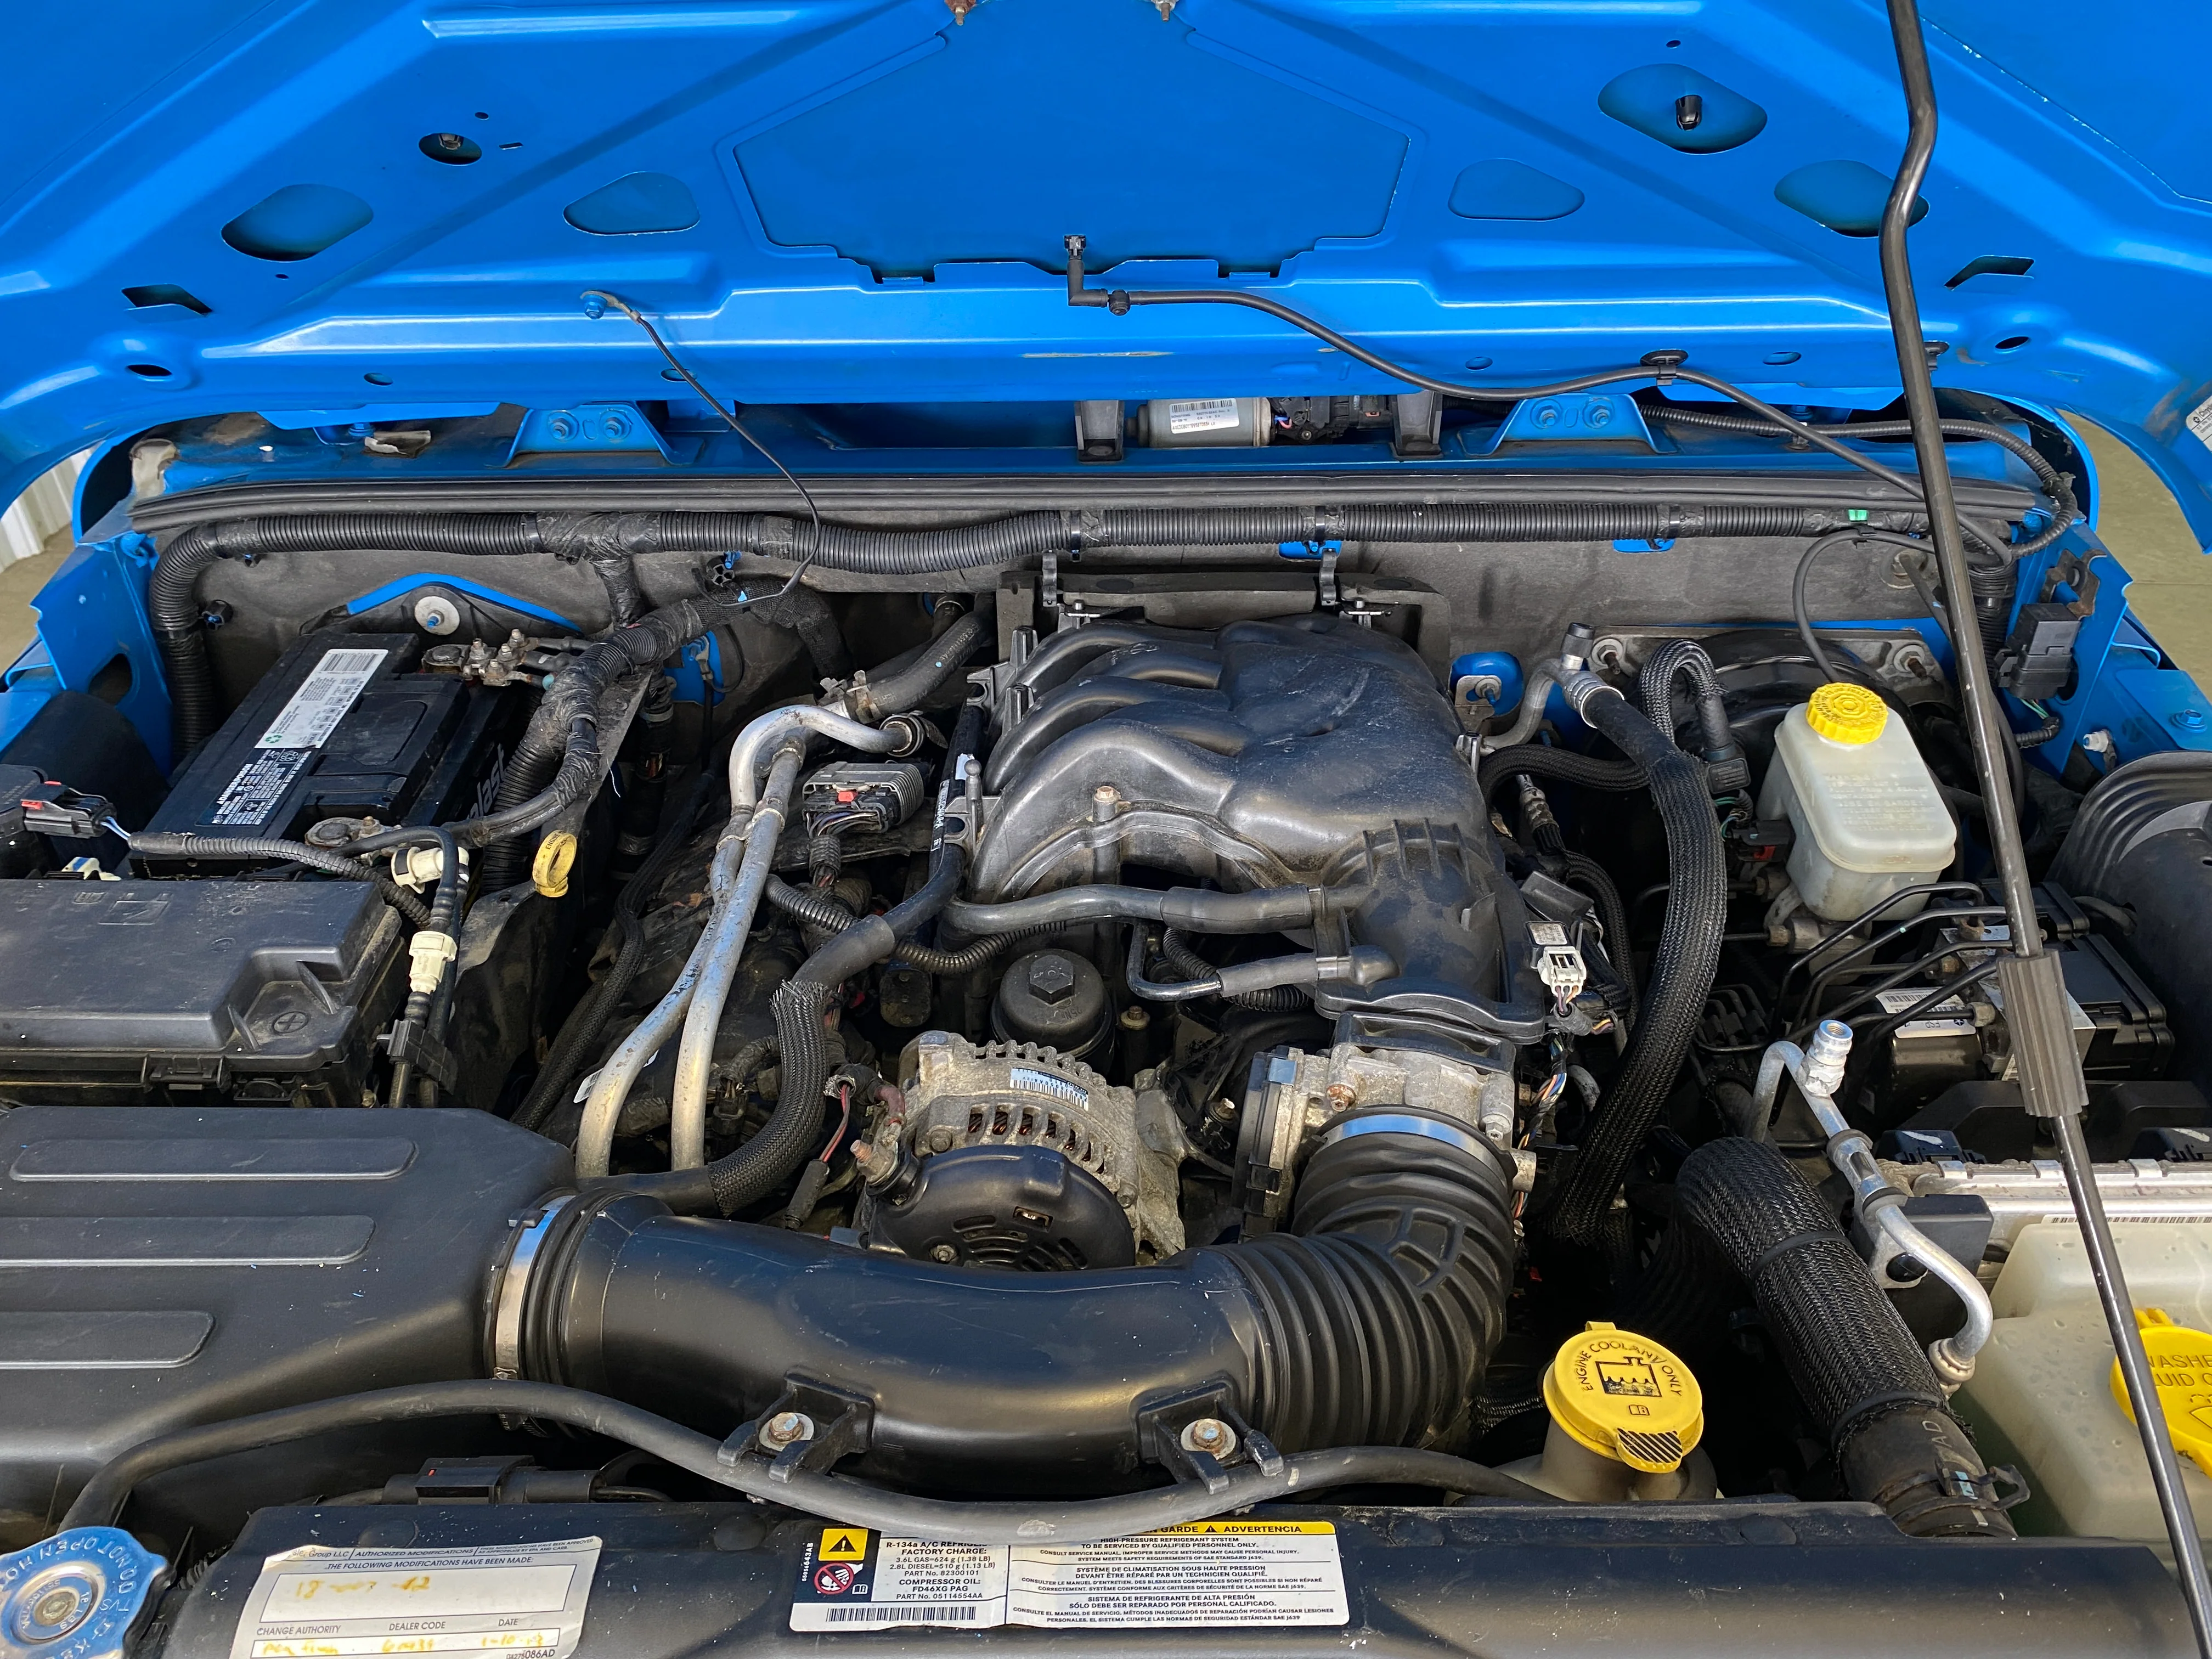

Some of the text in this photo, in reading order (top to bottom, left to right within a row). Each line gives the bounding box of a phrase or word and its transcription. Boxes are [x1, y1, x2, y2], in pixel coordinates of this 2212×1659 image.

[2148, 1355, 2212, 1368] ASHE
[1574, 1341, 1683, 1396] ENGINE COOLANT ONLY
[39, 1536, 98, 1560] OPEN
[394, 1559, 460, 1567] MODIFICATIONS
[389, 1621, 446, 1631] DEALER CODE
[498, 1618, 518, 1627] DATE
[256, 1624, 342, 1635] CHANGE AUTHORITY
